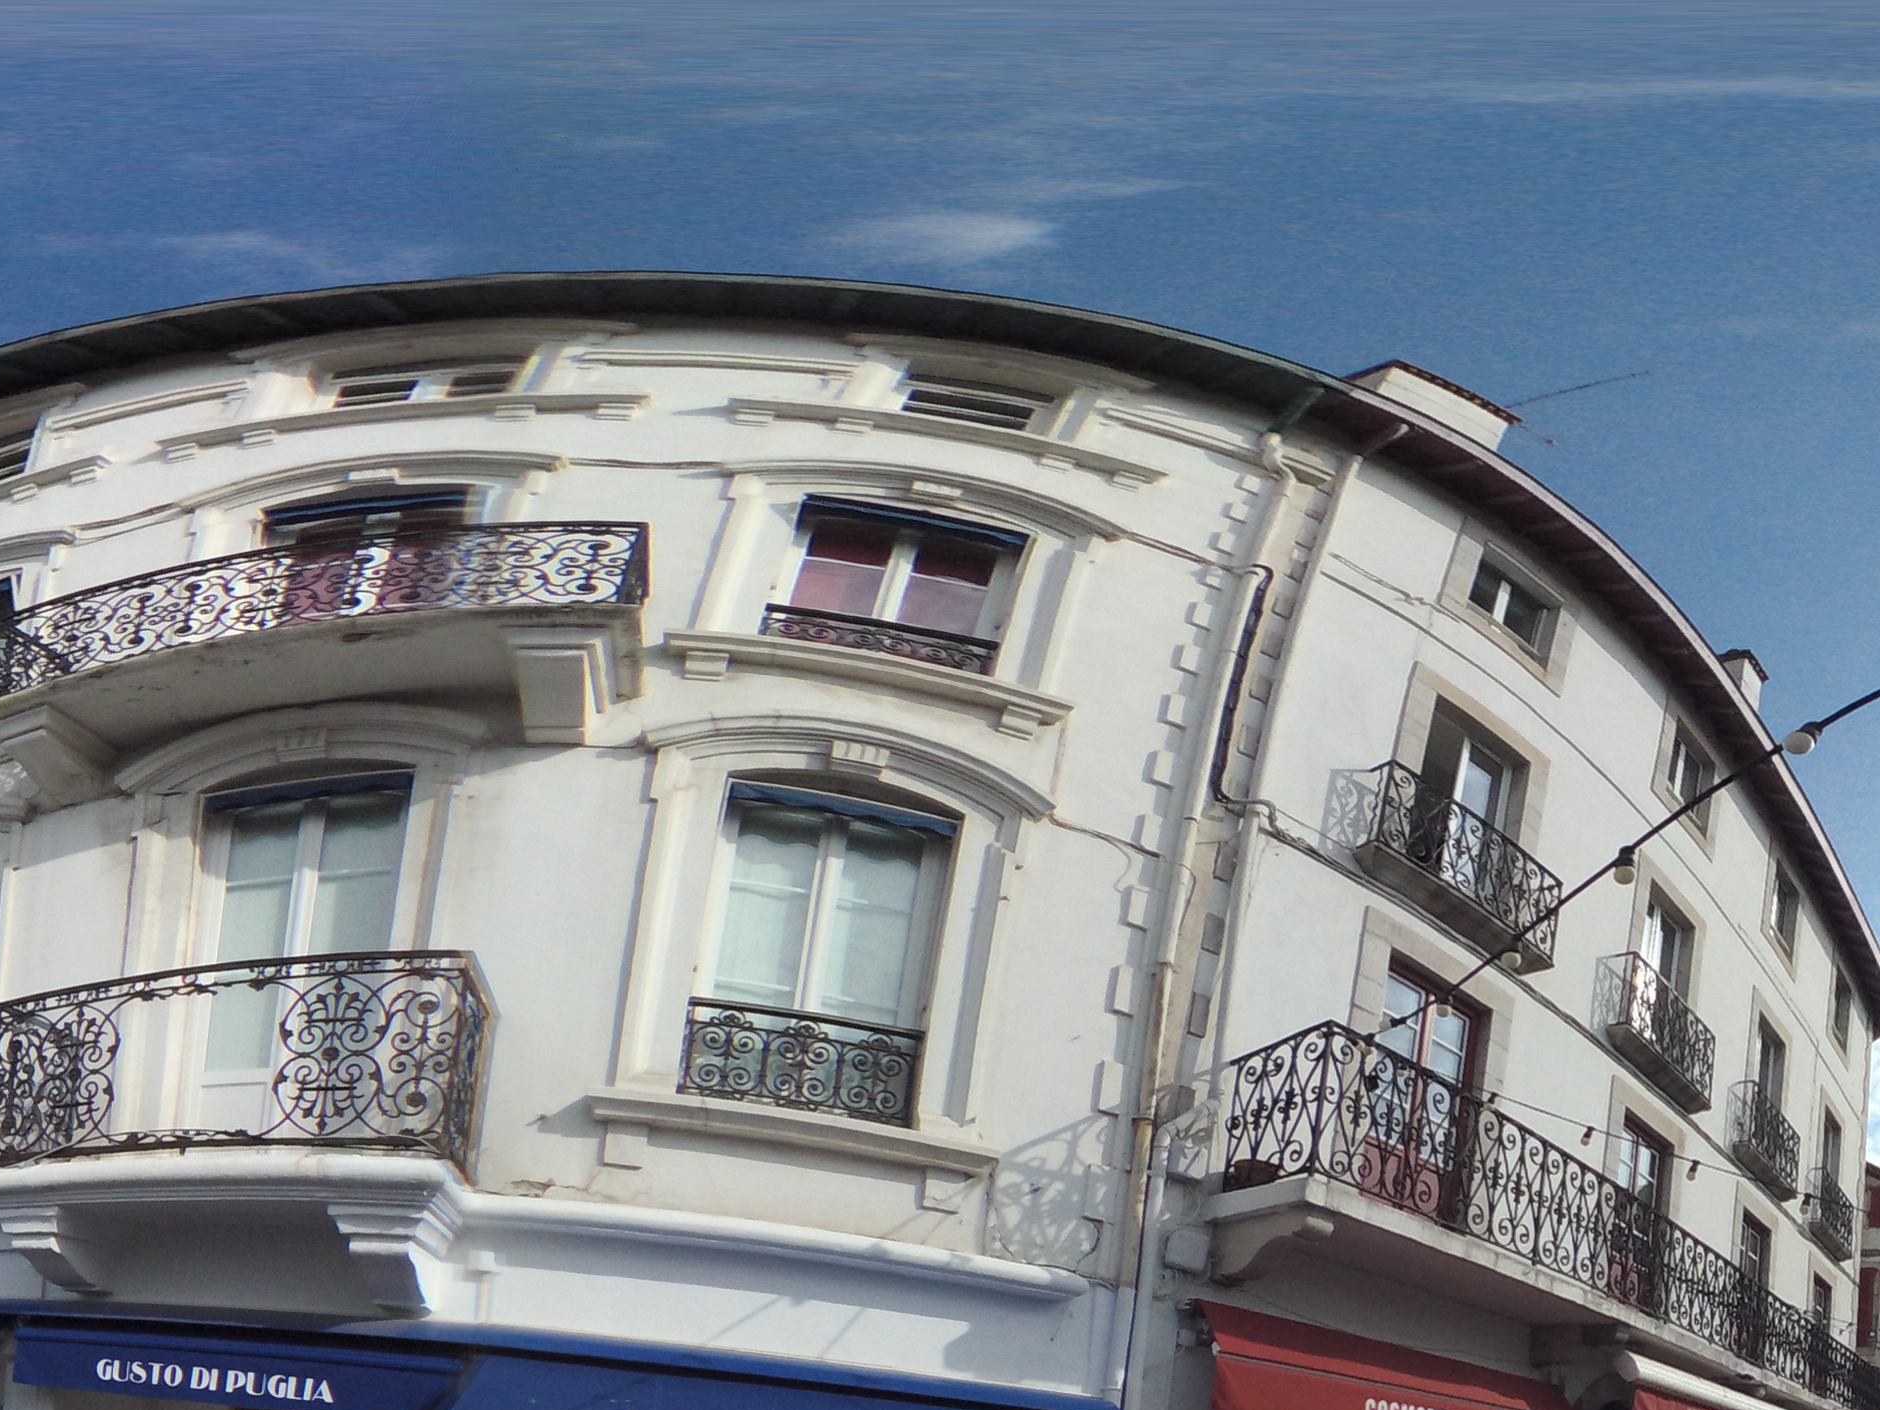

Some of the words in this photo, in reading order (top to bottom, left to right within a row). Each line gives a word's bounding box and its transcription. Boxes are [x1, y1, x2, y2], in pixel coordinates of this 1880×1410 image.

[96, 1358, 184, 1388] GUSTO
[190, 1366, 219, 1392] DI
[225, 1369, 334, 1403] PUGLIA
